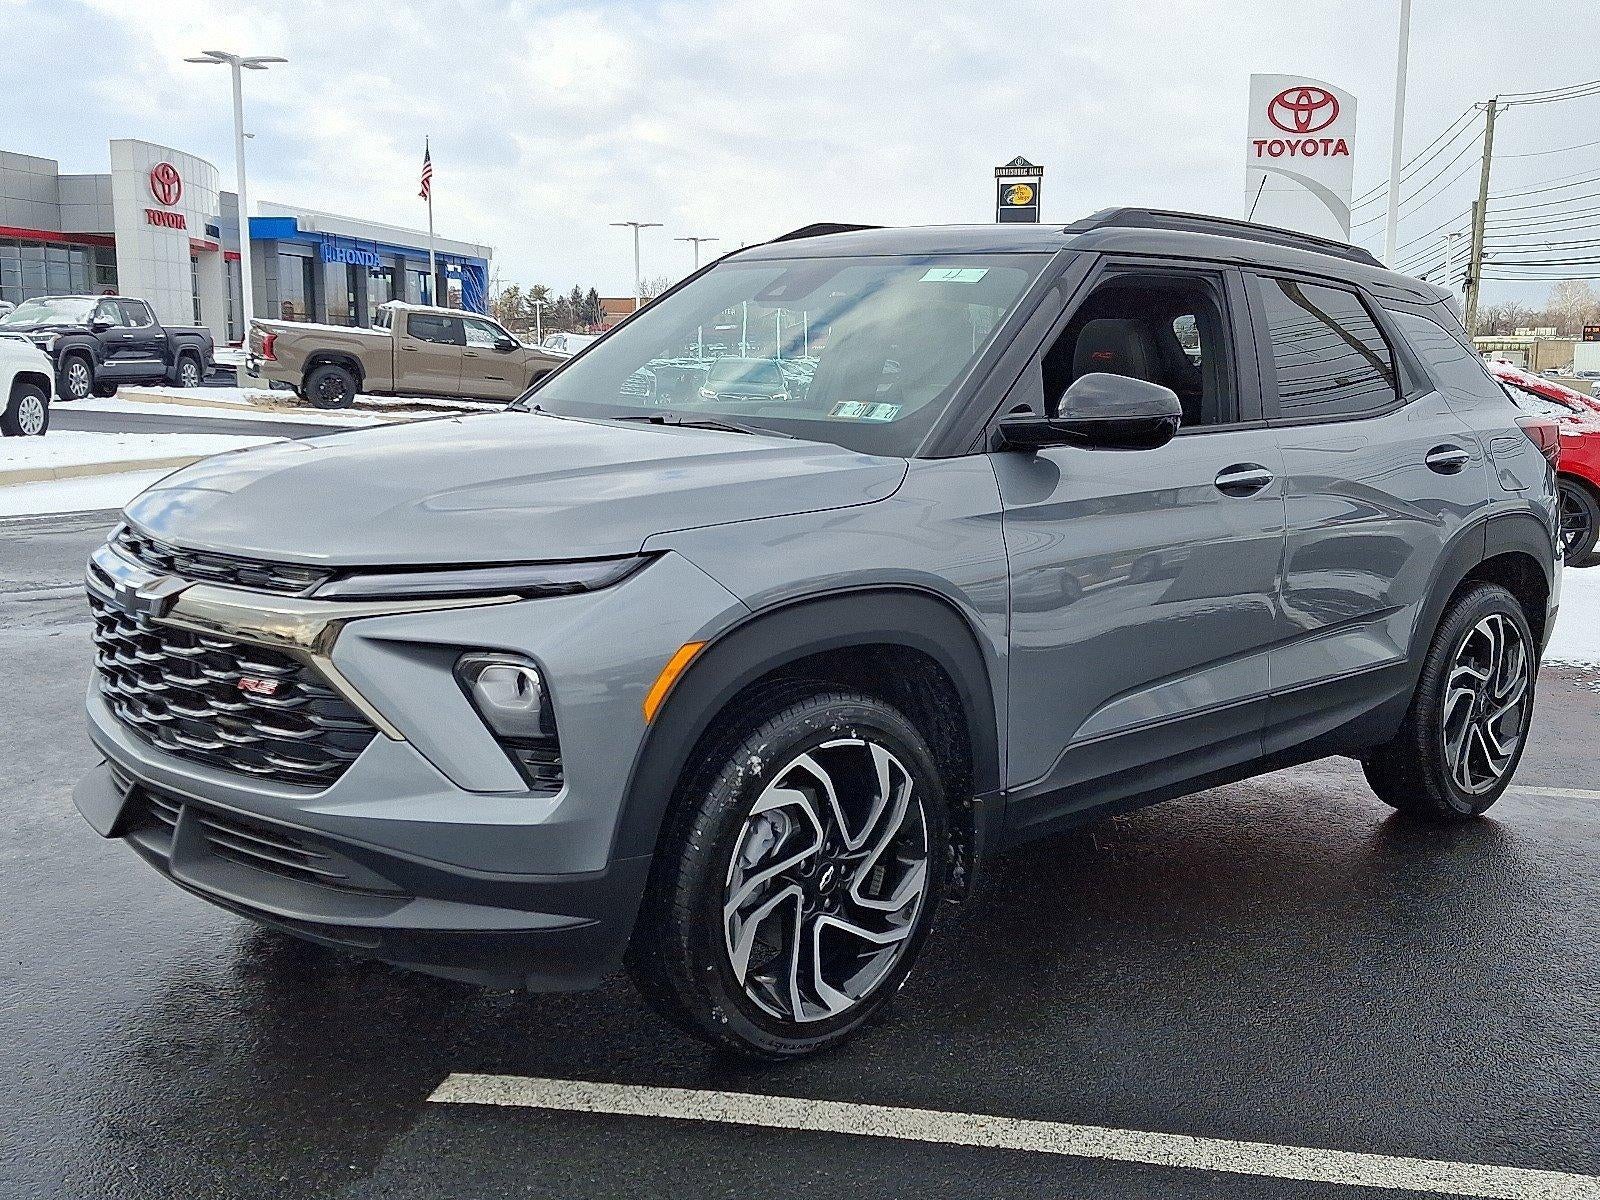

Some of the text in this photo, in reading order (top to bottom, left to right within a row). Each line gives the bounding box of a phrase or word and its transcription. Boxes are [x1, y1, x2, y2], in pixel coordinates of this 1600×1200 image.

[1253, 138, 1350, 157] TOYOTA
[145, 208, 187, 230] TOYOTA
[334, 248, 381, 267] HONDA
[237, 677, 277, 695] RS
